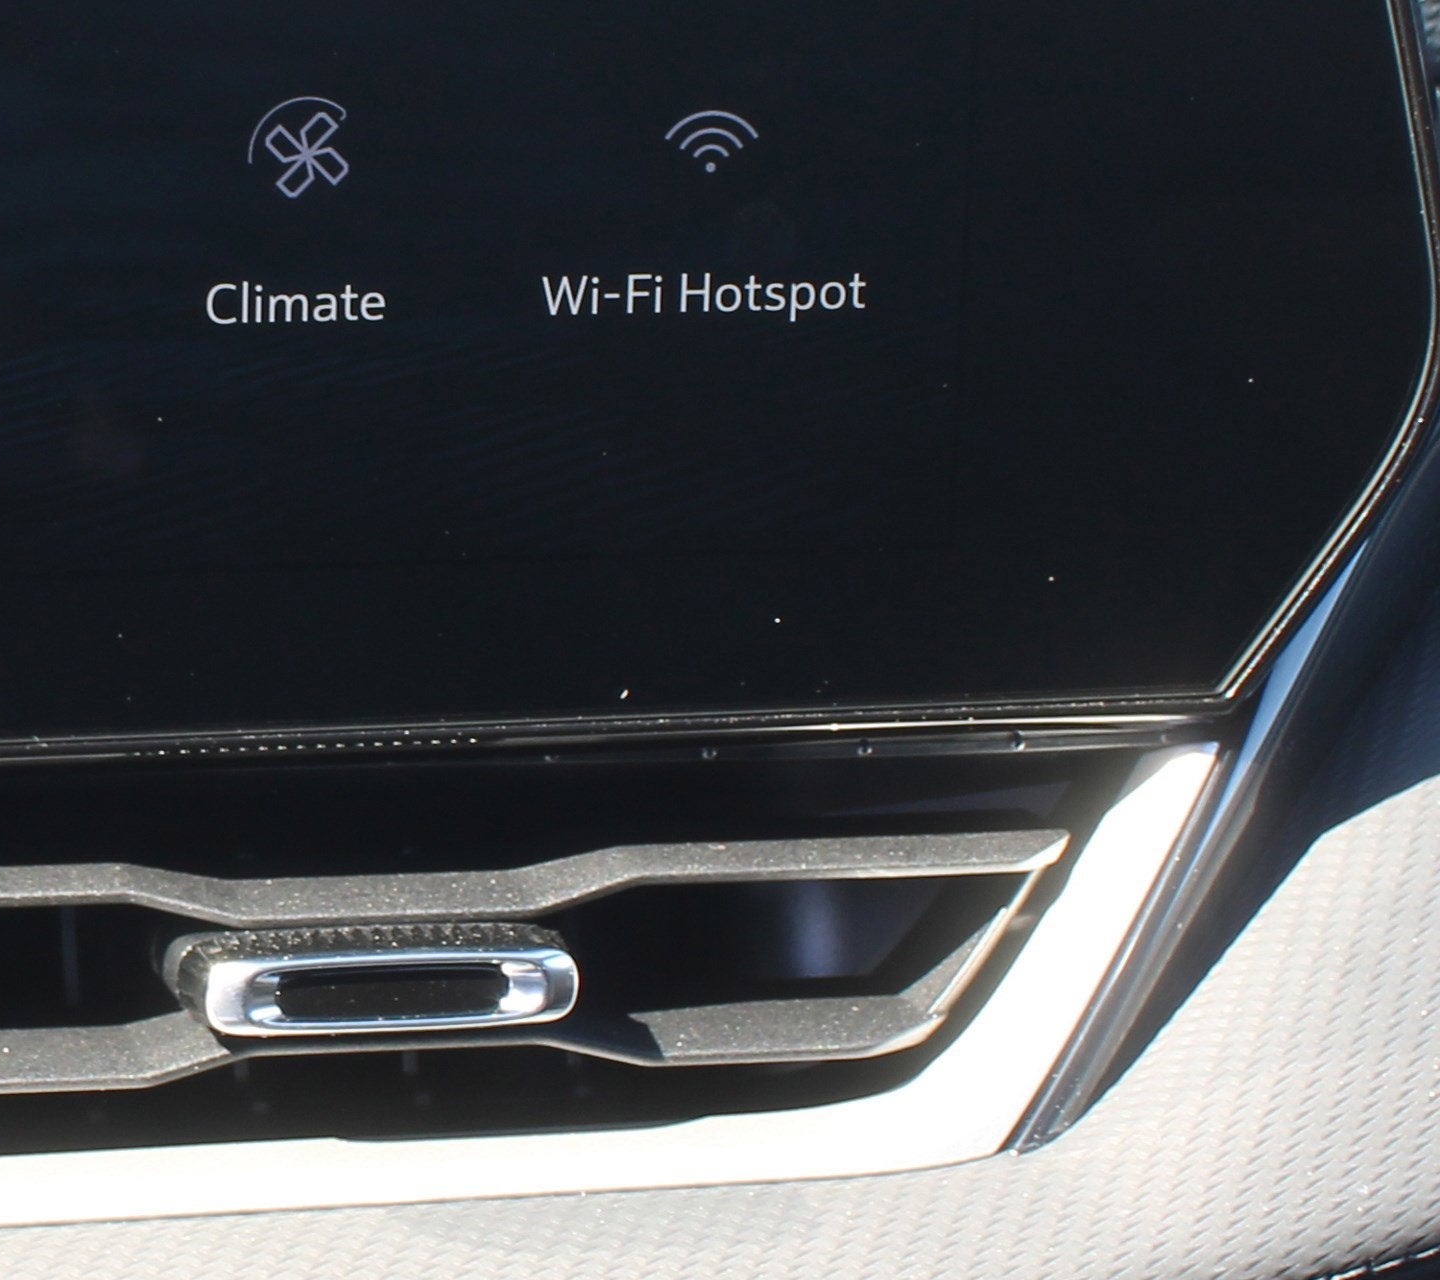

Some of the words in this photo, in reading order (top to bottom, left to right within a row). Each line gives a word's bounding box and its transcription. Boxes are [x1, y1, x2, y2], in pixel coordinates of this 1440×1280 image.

[204, 279, 387, 327] Climate
[540, 272, 664, 317] Wi-Fi
[678, 271, 867, 324] Hotspot
